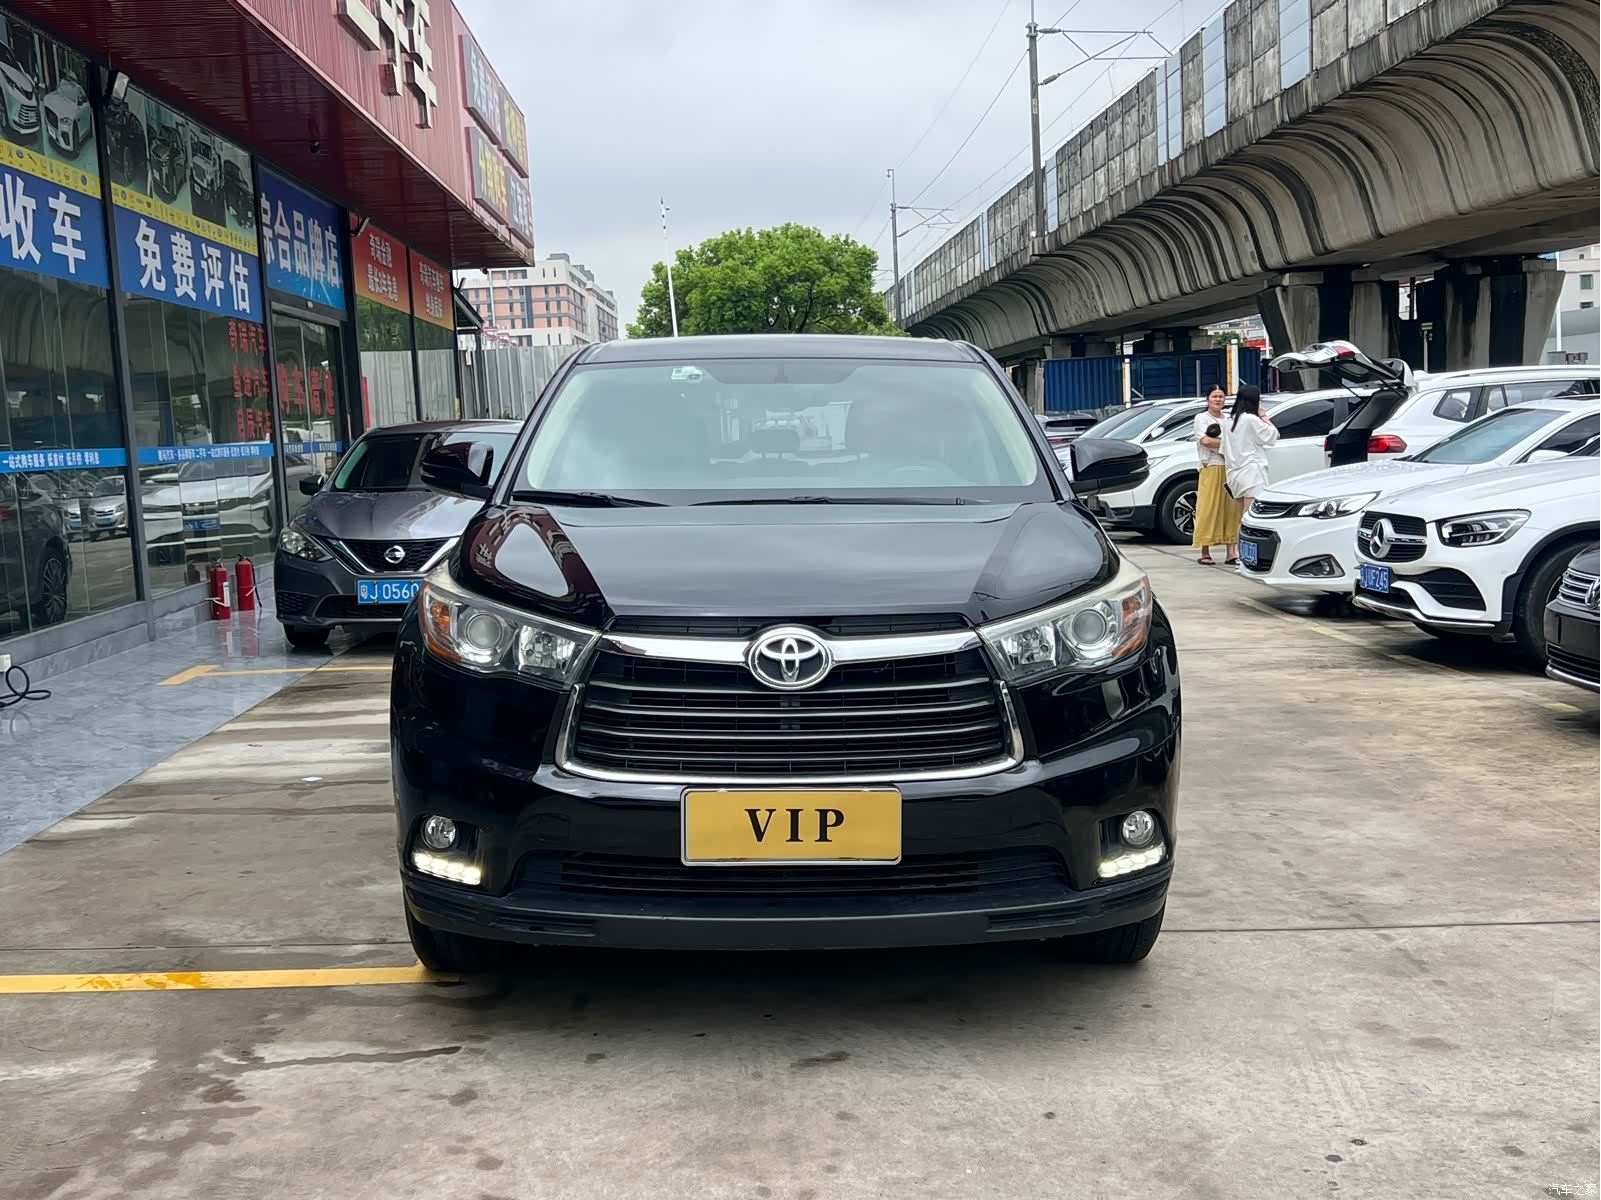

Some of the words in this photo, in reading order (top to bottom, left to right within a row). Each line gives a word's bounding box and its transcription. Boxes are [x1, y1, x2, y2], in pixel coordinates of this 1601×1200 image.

[0, 173, 86, 274] 收车
[135, 218, 250, 314] 免费评估
[744, 808, 845, 843] VIP
